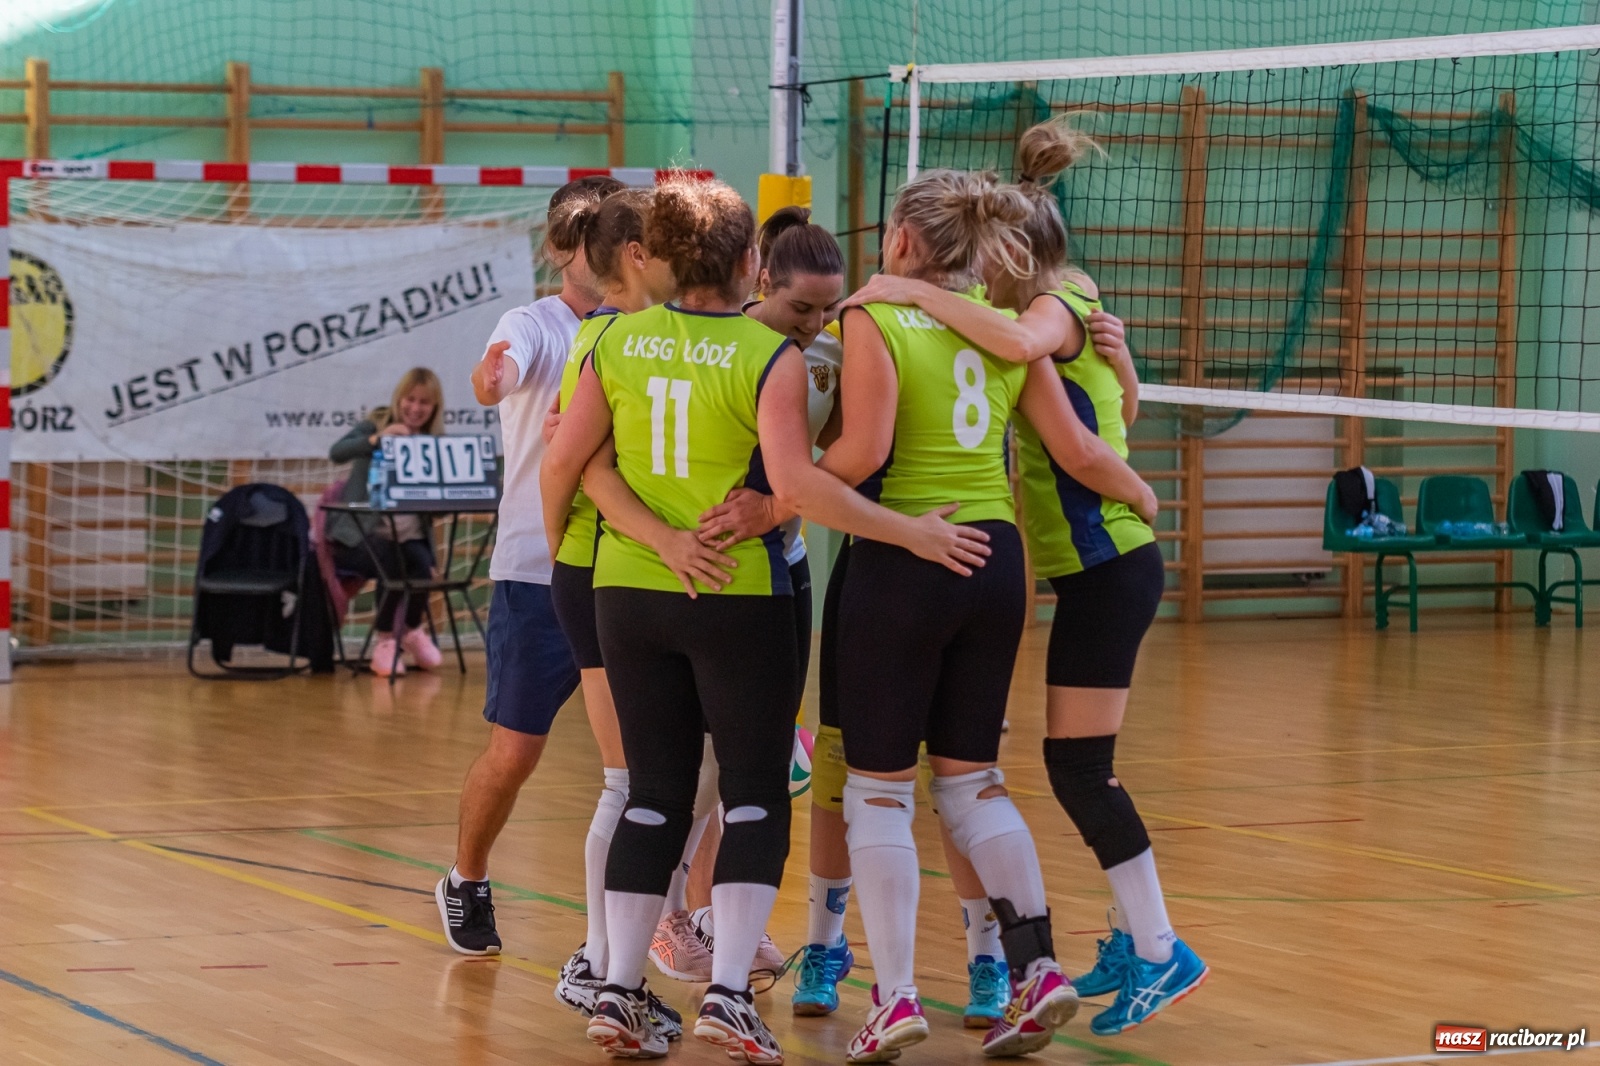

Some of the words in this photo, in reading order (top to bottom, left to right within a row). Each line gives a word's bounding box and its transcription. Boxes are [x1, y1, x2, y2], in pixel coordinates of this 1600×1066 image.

[105, 359, 200, 420] JEST
[213, 342, 254, 382] W
[263, 262, 499, 367] PORZĄDKU!
[623, 334, 676, 361] ŁKSG
[683, 337, 739, 369] ŁÓDŹ
[646, 376, 692, 478] 11
[953, 349, 990, 449] 8
[400, 444, 432, 477] 25
[445, 443, 475, 477] 17
